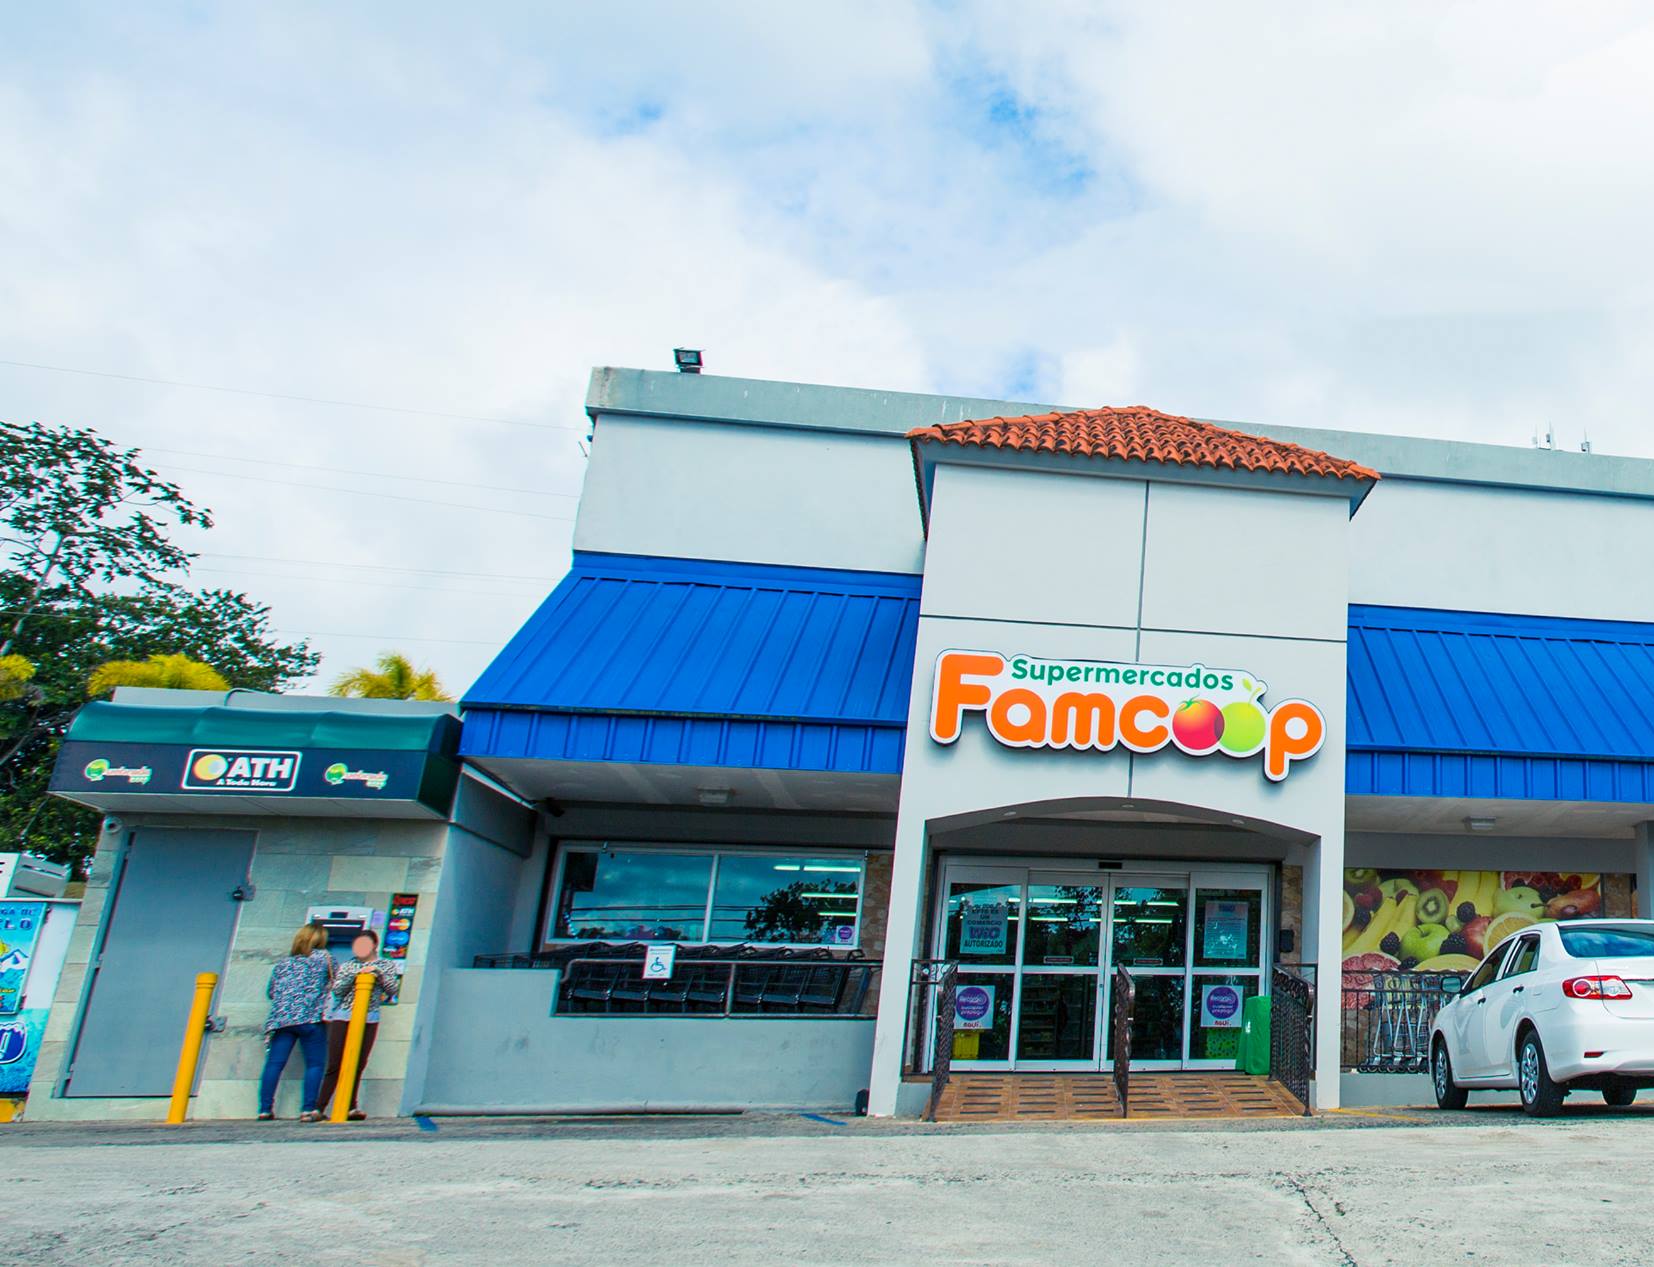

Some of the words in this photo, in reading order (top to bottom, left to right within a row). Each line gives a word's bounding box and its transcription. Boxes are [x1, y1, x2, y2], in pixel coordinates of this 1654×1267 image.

[1011, 659, 1234, 690] Supermercados
[935, 653, 1322, 776] Famcoop
[227, 757, 294, 778] ATH
[964, 940, 1004, 948] AUTORIZADO
